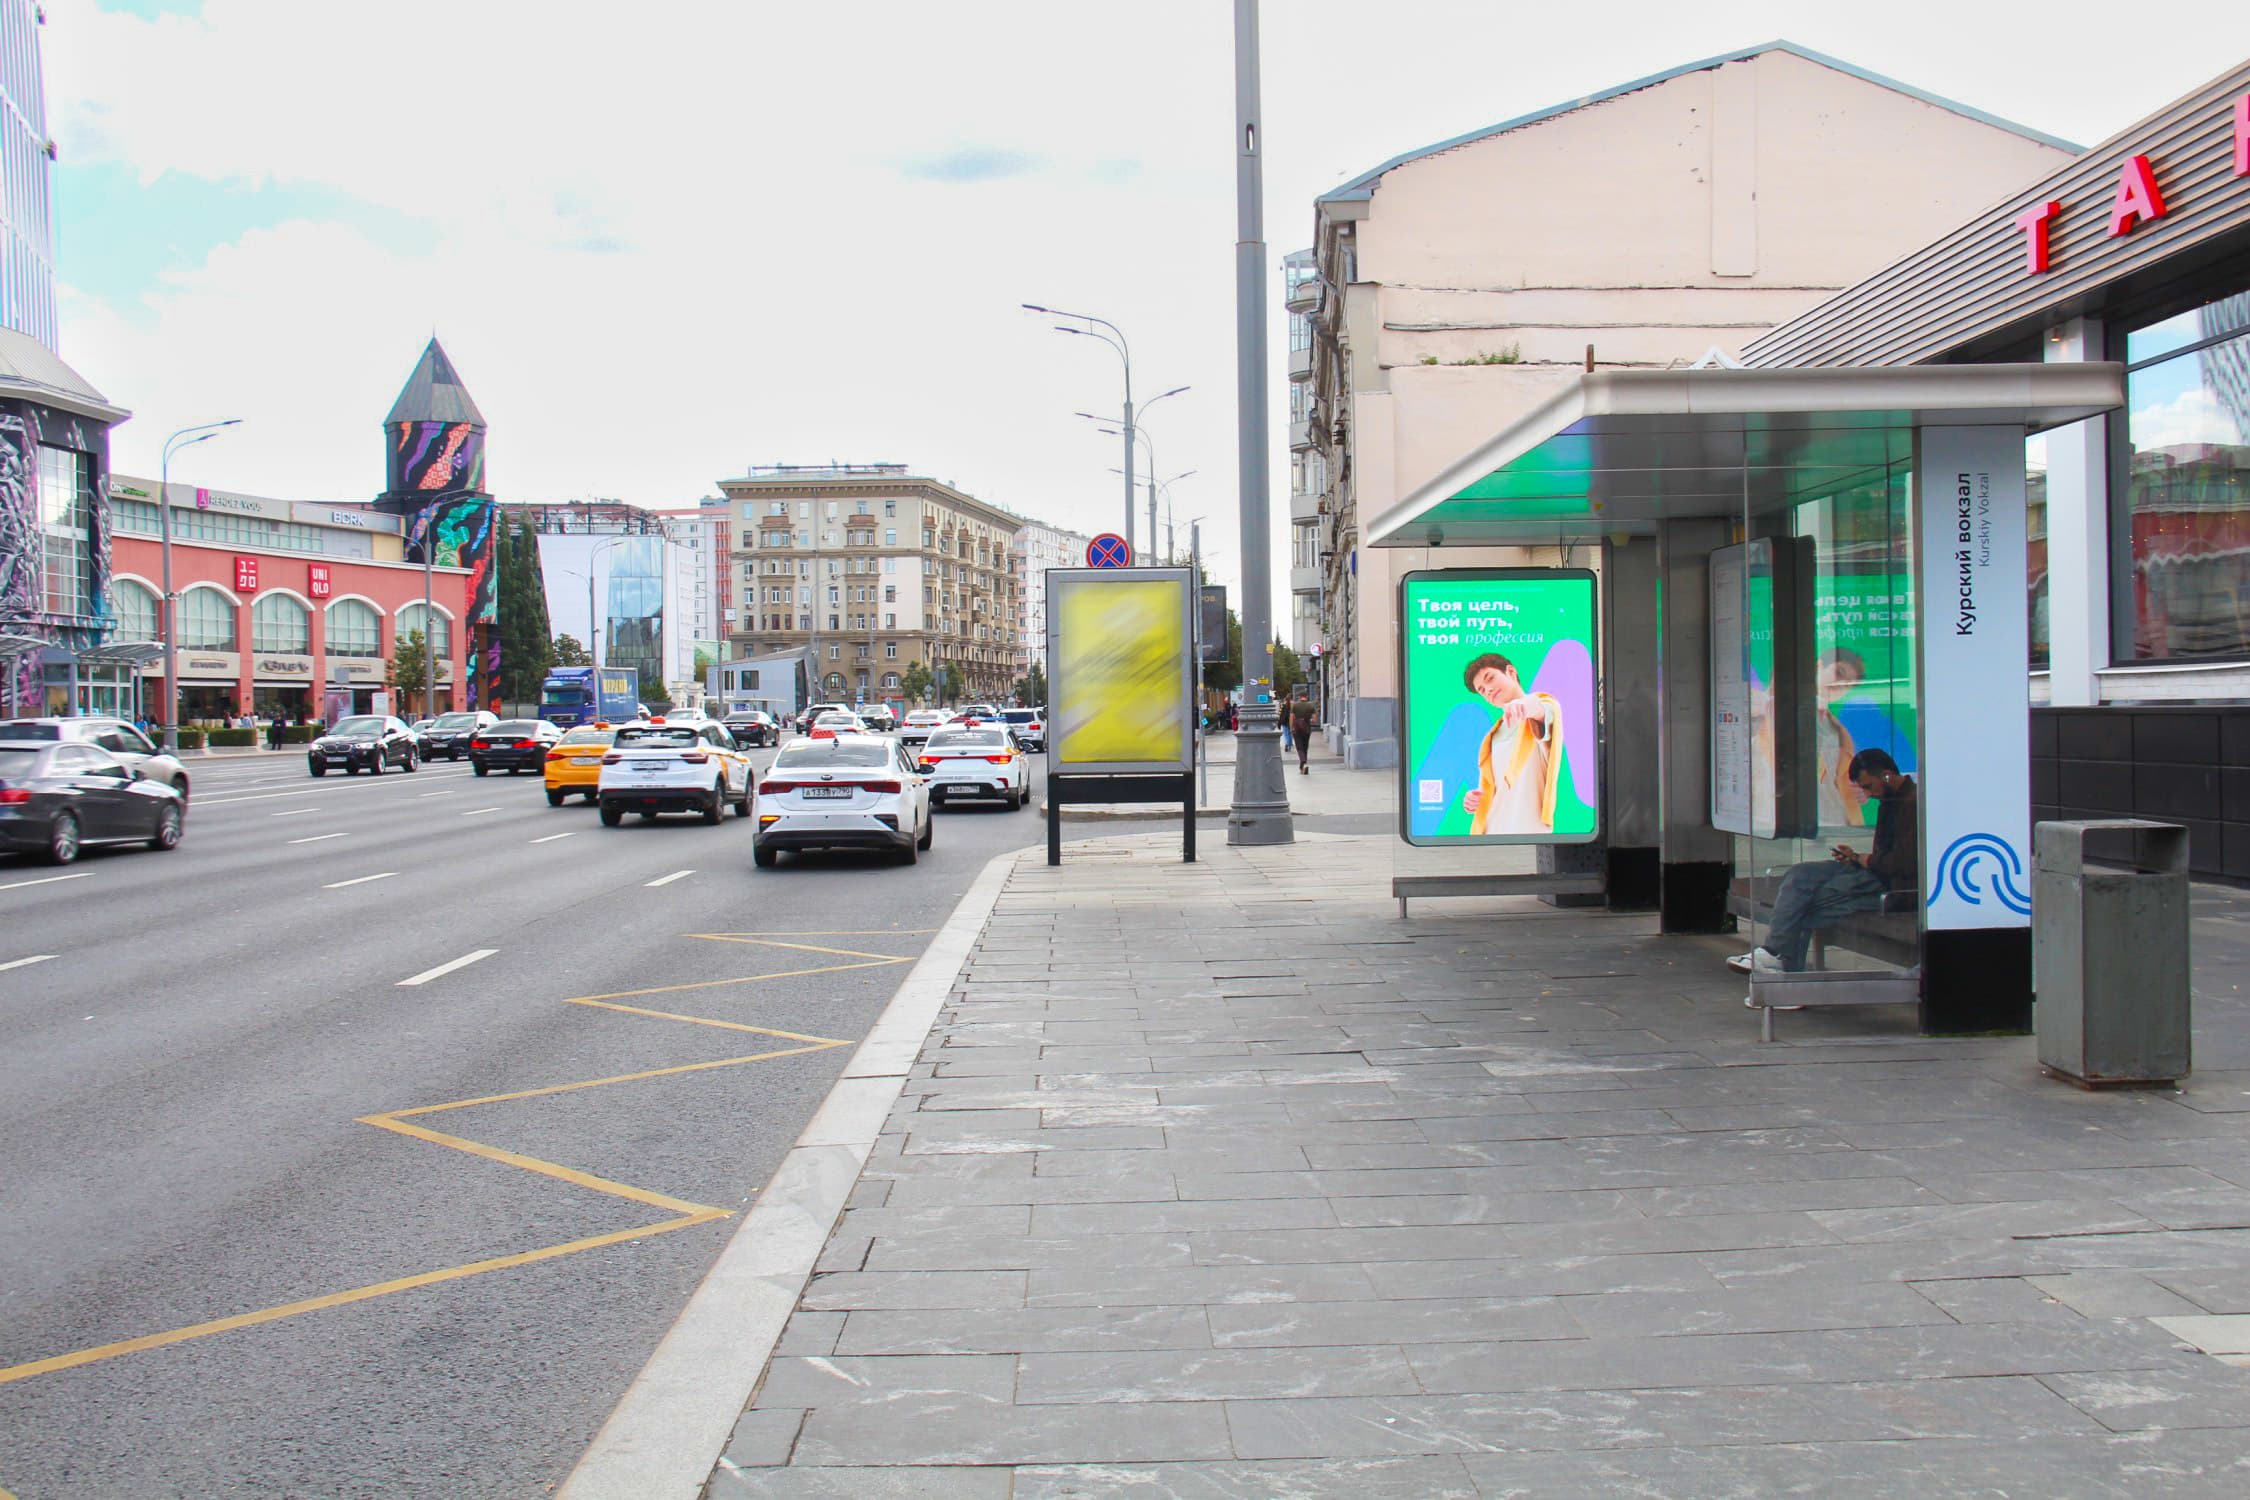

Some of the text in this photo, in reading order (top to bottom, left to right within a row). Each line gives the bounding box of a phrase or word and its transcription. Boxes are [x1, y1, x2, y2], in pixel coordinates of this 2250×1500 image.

[1977, 472, 1992, 567] Kurskiy Vokzal
[1955, 472, 1976, 635] Курский вокзал
[312, 568, 328, 581] UNI
[312, 582, 329, 595] QLO
[1417, 598, 1519, 614] Твоя цель,
[1417, 614, 1513, 631] твой путь,
[1417, 630, 1544, 647] твоя профессия
